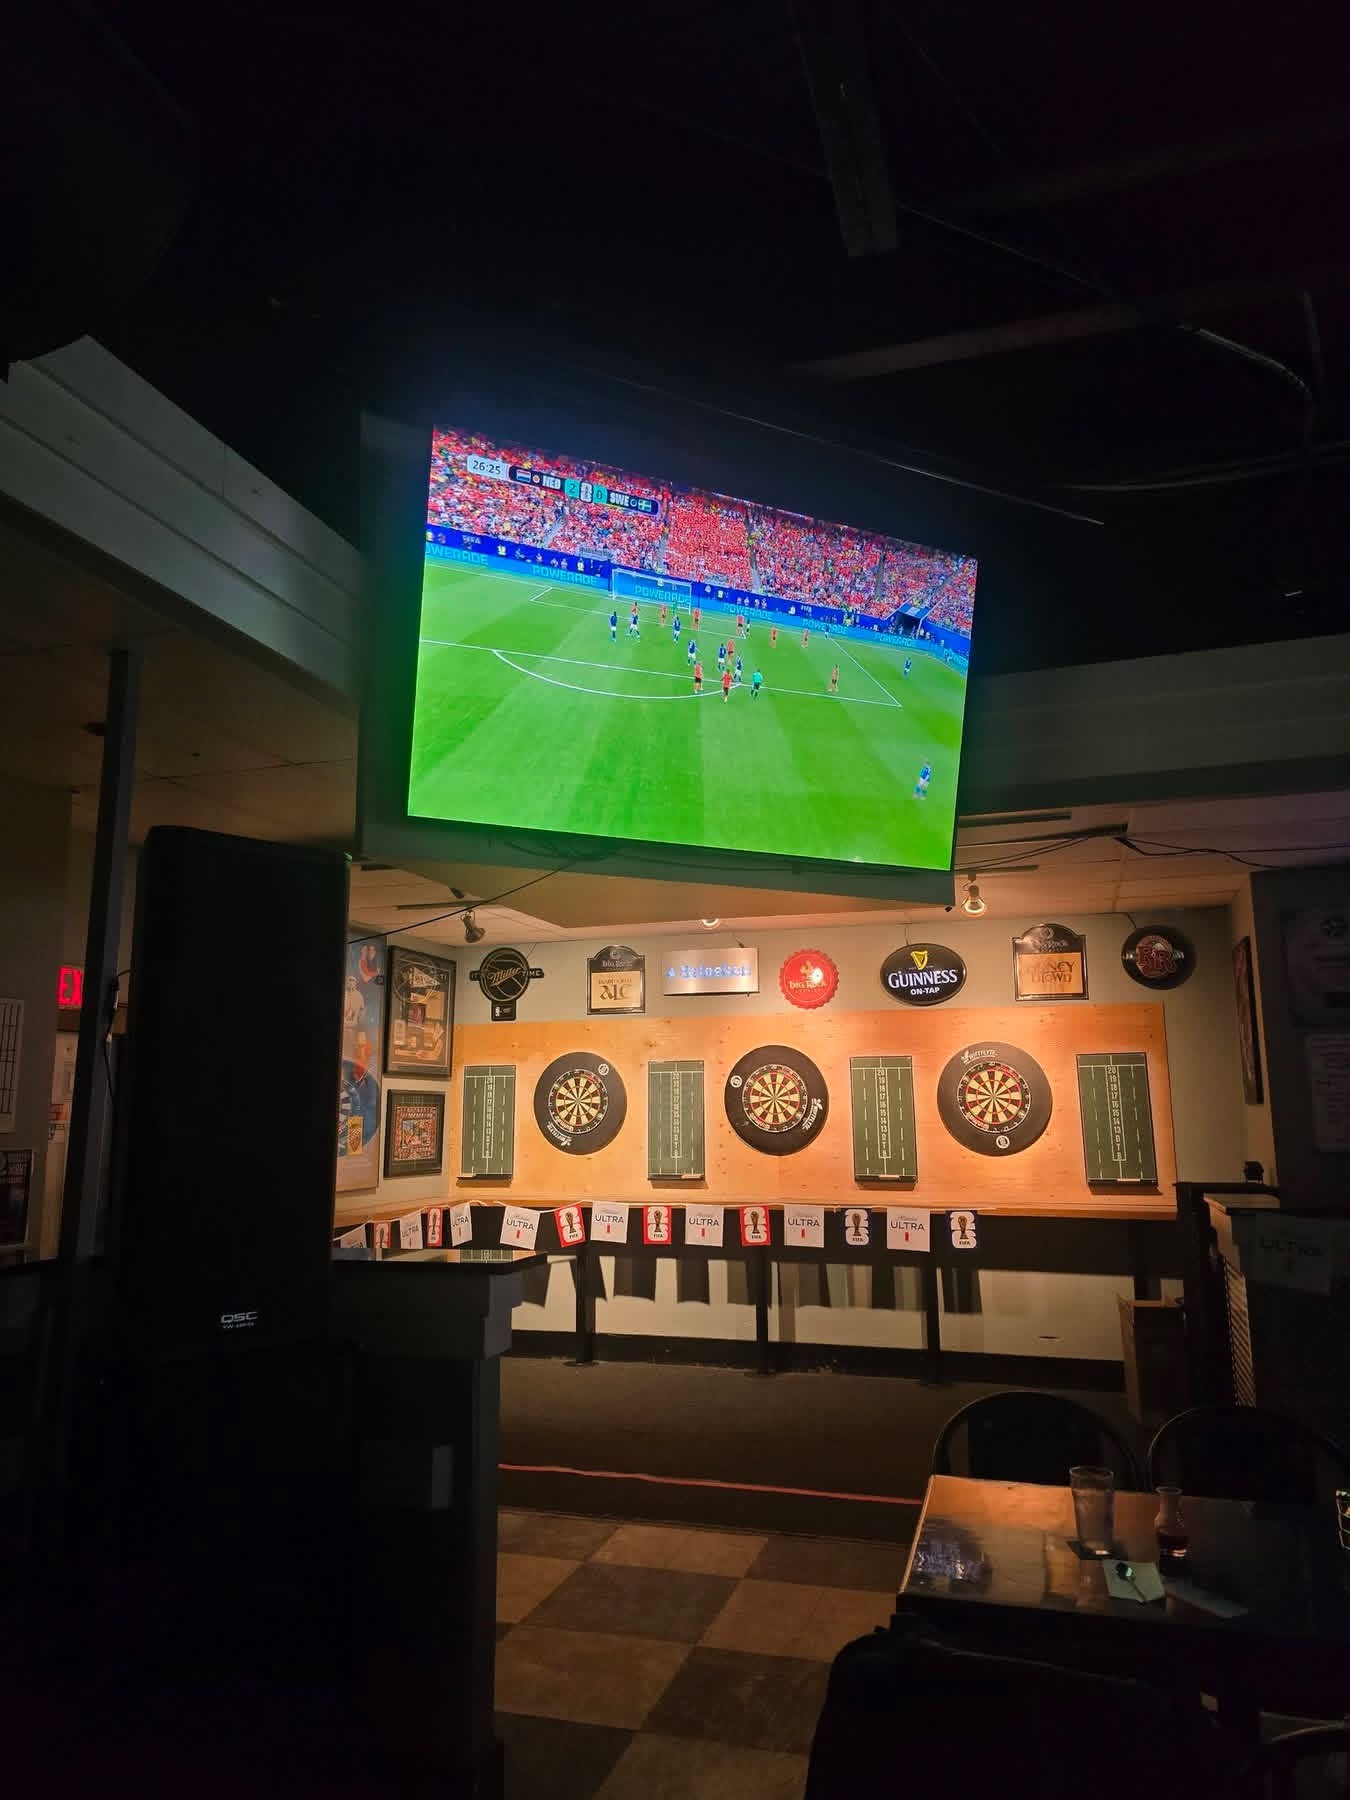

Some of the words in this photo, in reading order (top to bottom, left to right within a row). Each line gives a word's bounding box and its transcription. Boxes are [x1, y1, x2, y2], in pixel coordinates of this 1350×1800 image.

[473, 460, 501, 474] 26:25
[542, 476, 561, 489] NED
[569, 483, 576, 493] 2
[596, 490, 602, 499] 0
[610, 493, 629, 506] SWE
[532, 565, 597, 585] POWERADE
[488, 968, 521, 985] Miller
[888, 969, 958, 988] GUINNESS
[910, 987, 940, 996] ON-TAP
[1111, 1092, 1118, 1100] 17
[1116, 1143, 1120, 1151] T
[506, 1218, 534, 1231] ULTRA
[595, 1215, 624, 1224] ULTRA
[689, 1218, 719, 1227] ULTRA
[787, 1218, 820, 1227] ULTRA
[891, 1221, 925, 1231] ULTRA
[221, 1312, 257, 1323] QSC
